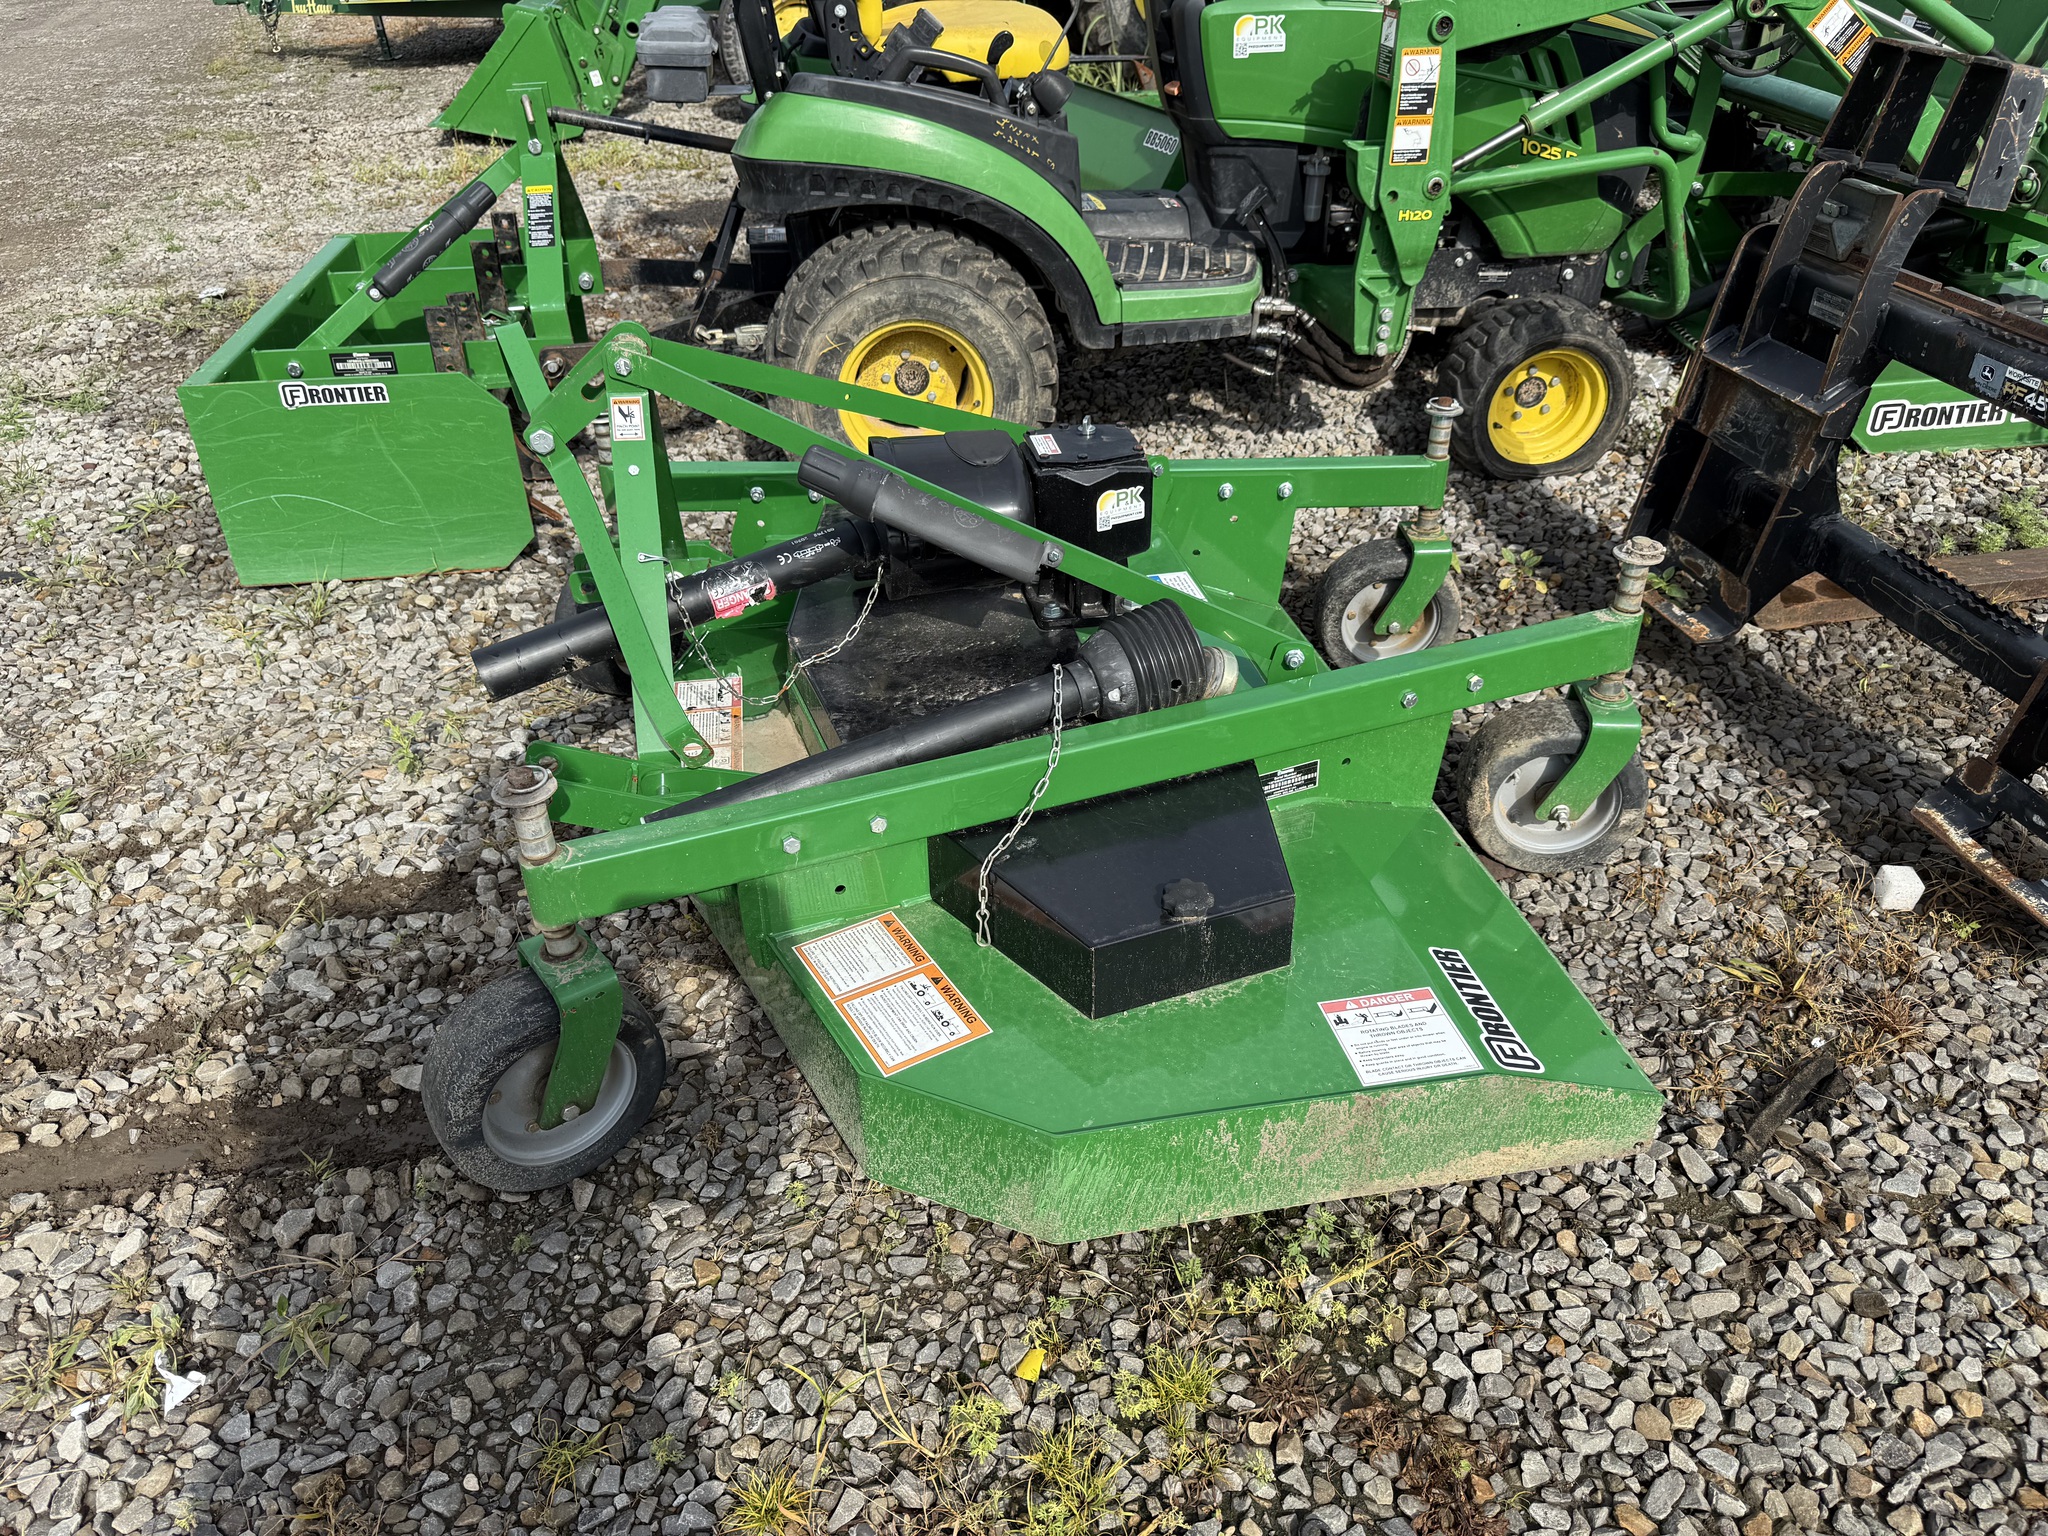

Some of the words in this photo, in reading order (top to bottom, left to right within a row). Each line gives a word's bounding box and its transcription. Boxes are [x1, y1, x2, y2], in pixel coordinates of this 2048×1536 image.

[1817, 0, 1838, 21] WARNIN
[1402, 118, 1431, 126] WARNING
[1145, 130, 1178, 153] BB5060
[1398, 209, 1432, 221] H120
[281, 384, 387, 407] FRONTIER
[1870, 402, 2003, 433] FRONTIER
[1100, 504, 1142, 515] EQUIPMENT
[891, 926, 925, 962] WARNING
[938, 984, 978, 1024] WARNING
[1358, 992, 1414, 1006] DANGER
[1432, 948, 1541, 1070] FRONTIER
[1359, 1026, 1390, 1034] ROTATING
[1369, 1030, 1396, 1038] THROWN
[1395, 1026, 1424, 1034] OBJECTS
